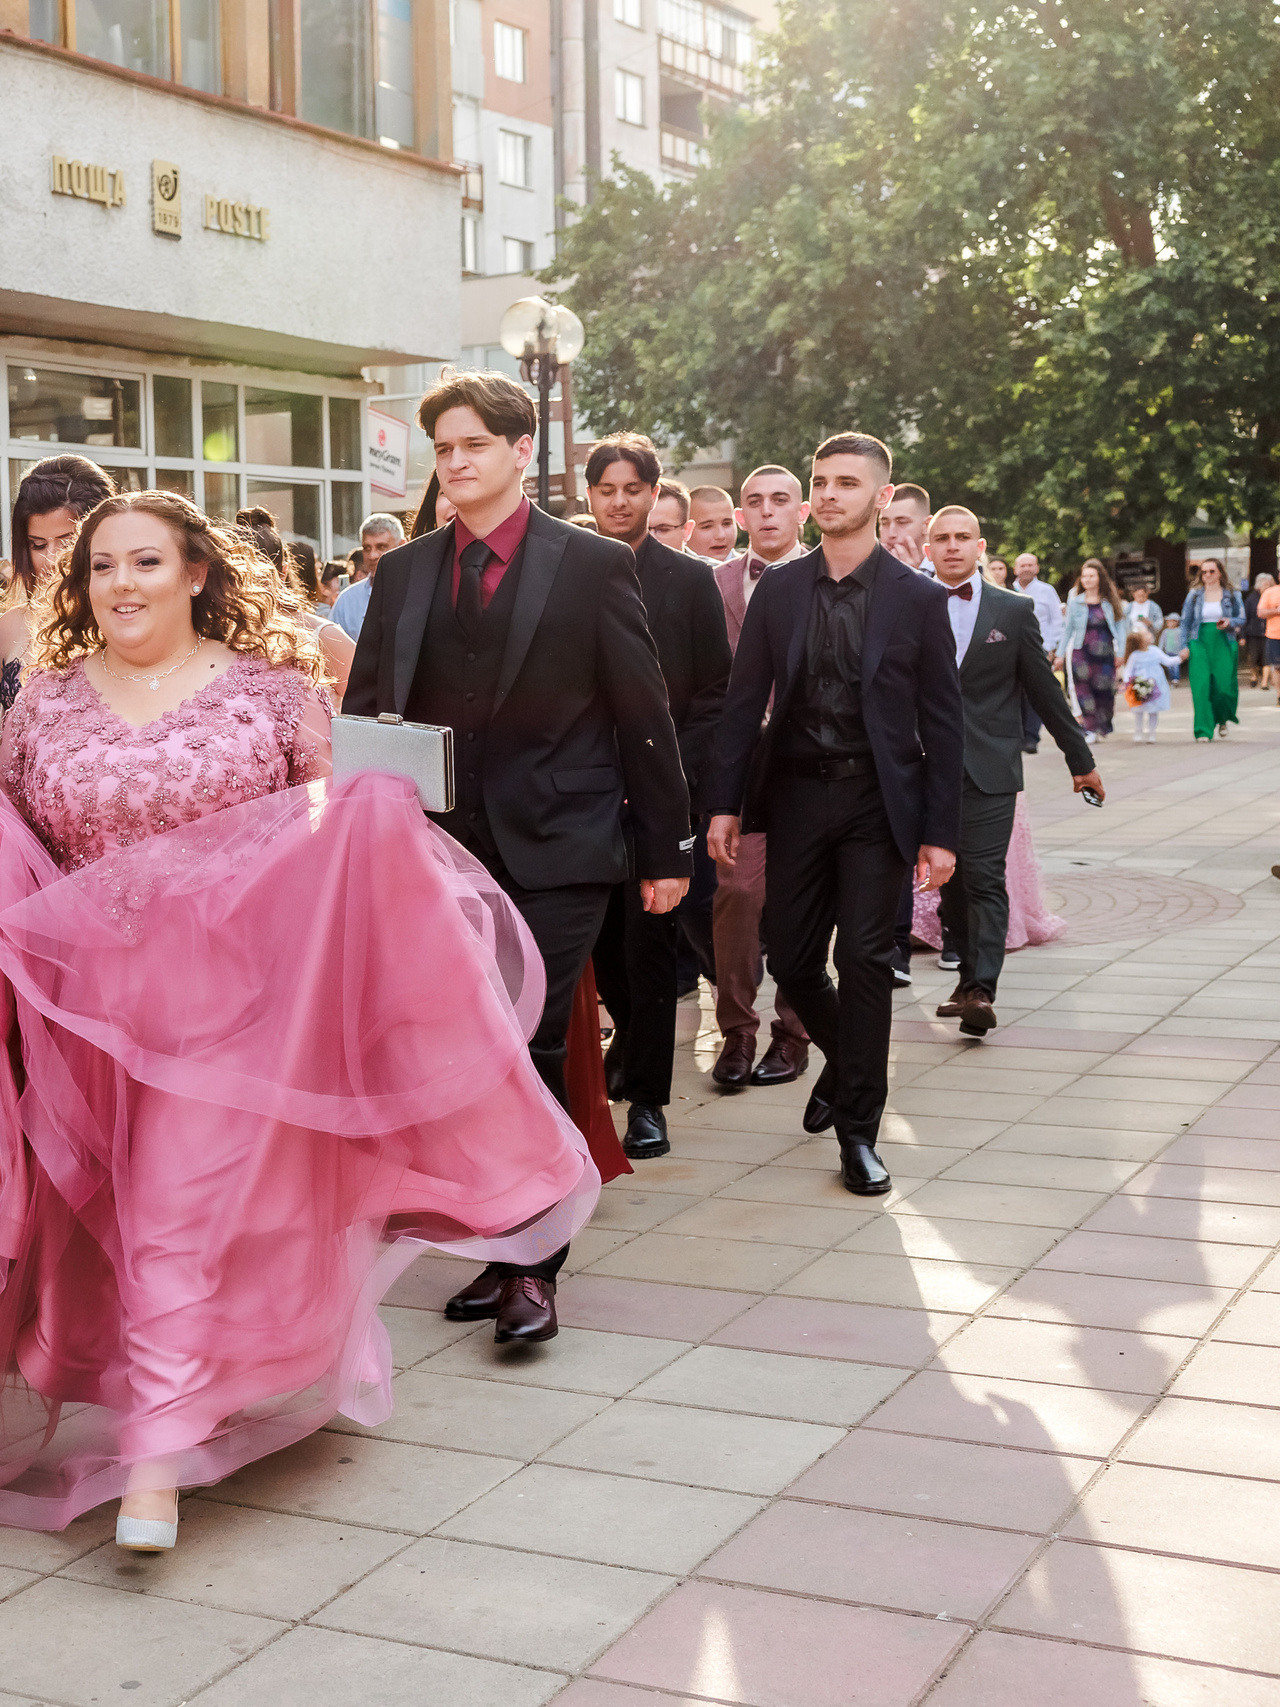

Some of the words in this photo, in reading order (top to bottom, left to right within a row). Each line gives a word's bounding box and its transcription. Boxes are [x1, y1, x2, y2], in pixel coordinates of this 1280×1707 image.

[52, 155, 127, 209] ПОЩА
[157, 211, 180, 228] 1879
[204, 193, 271, 241] POSTE
